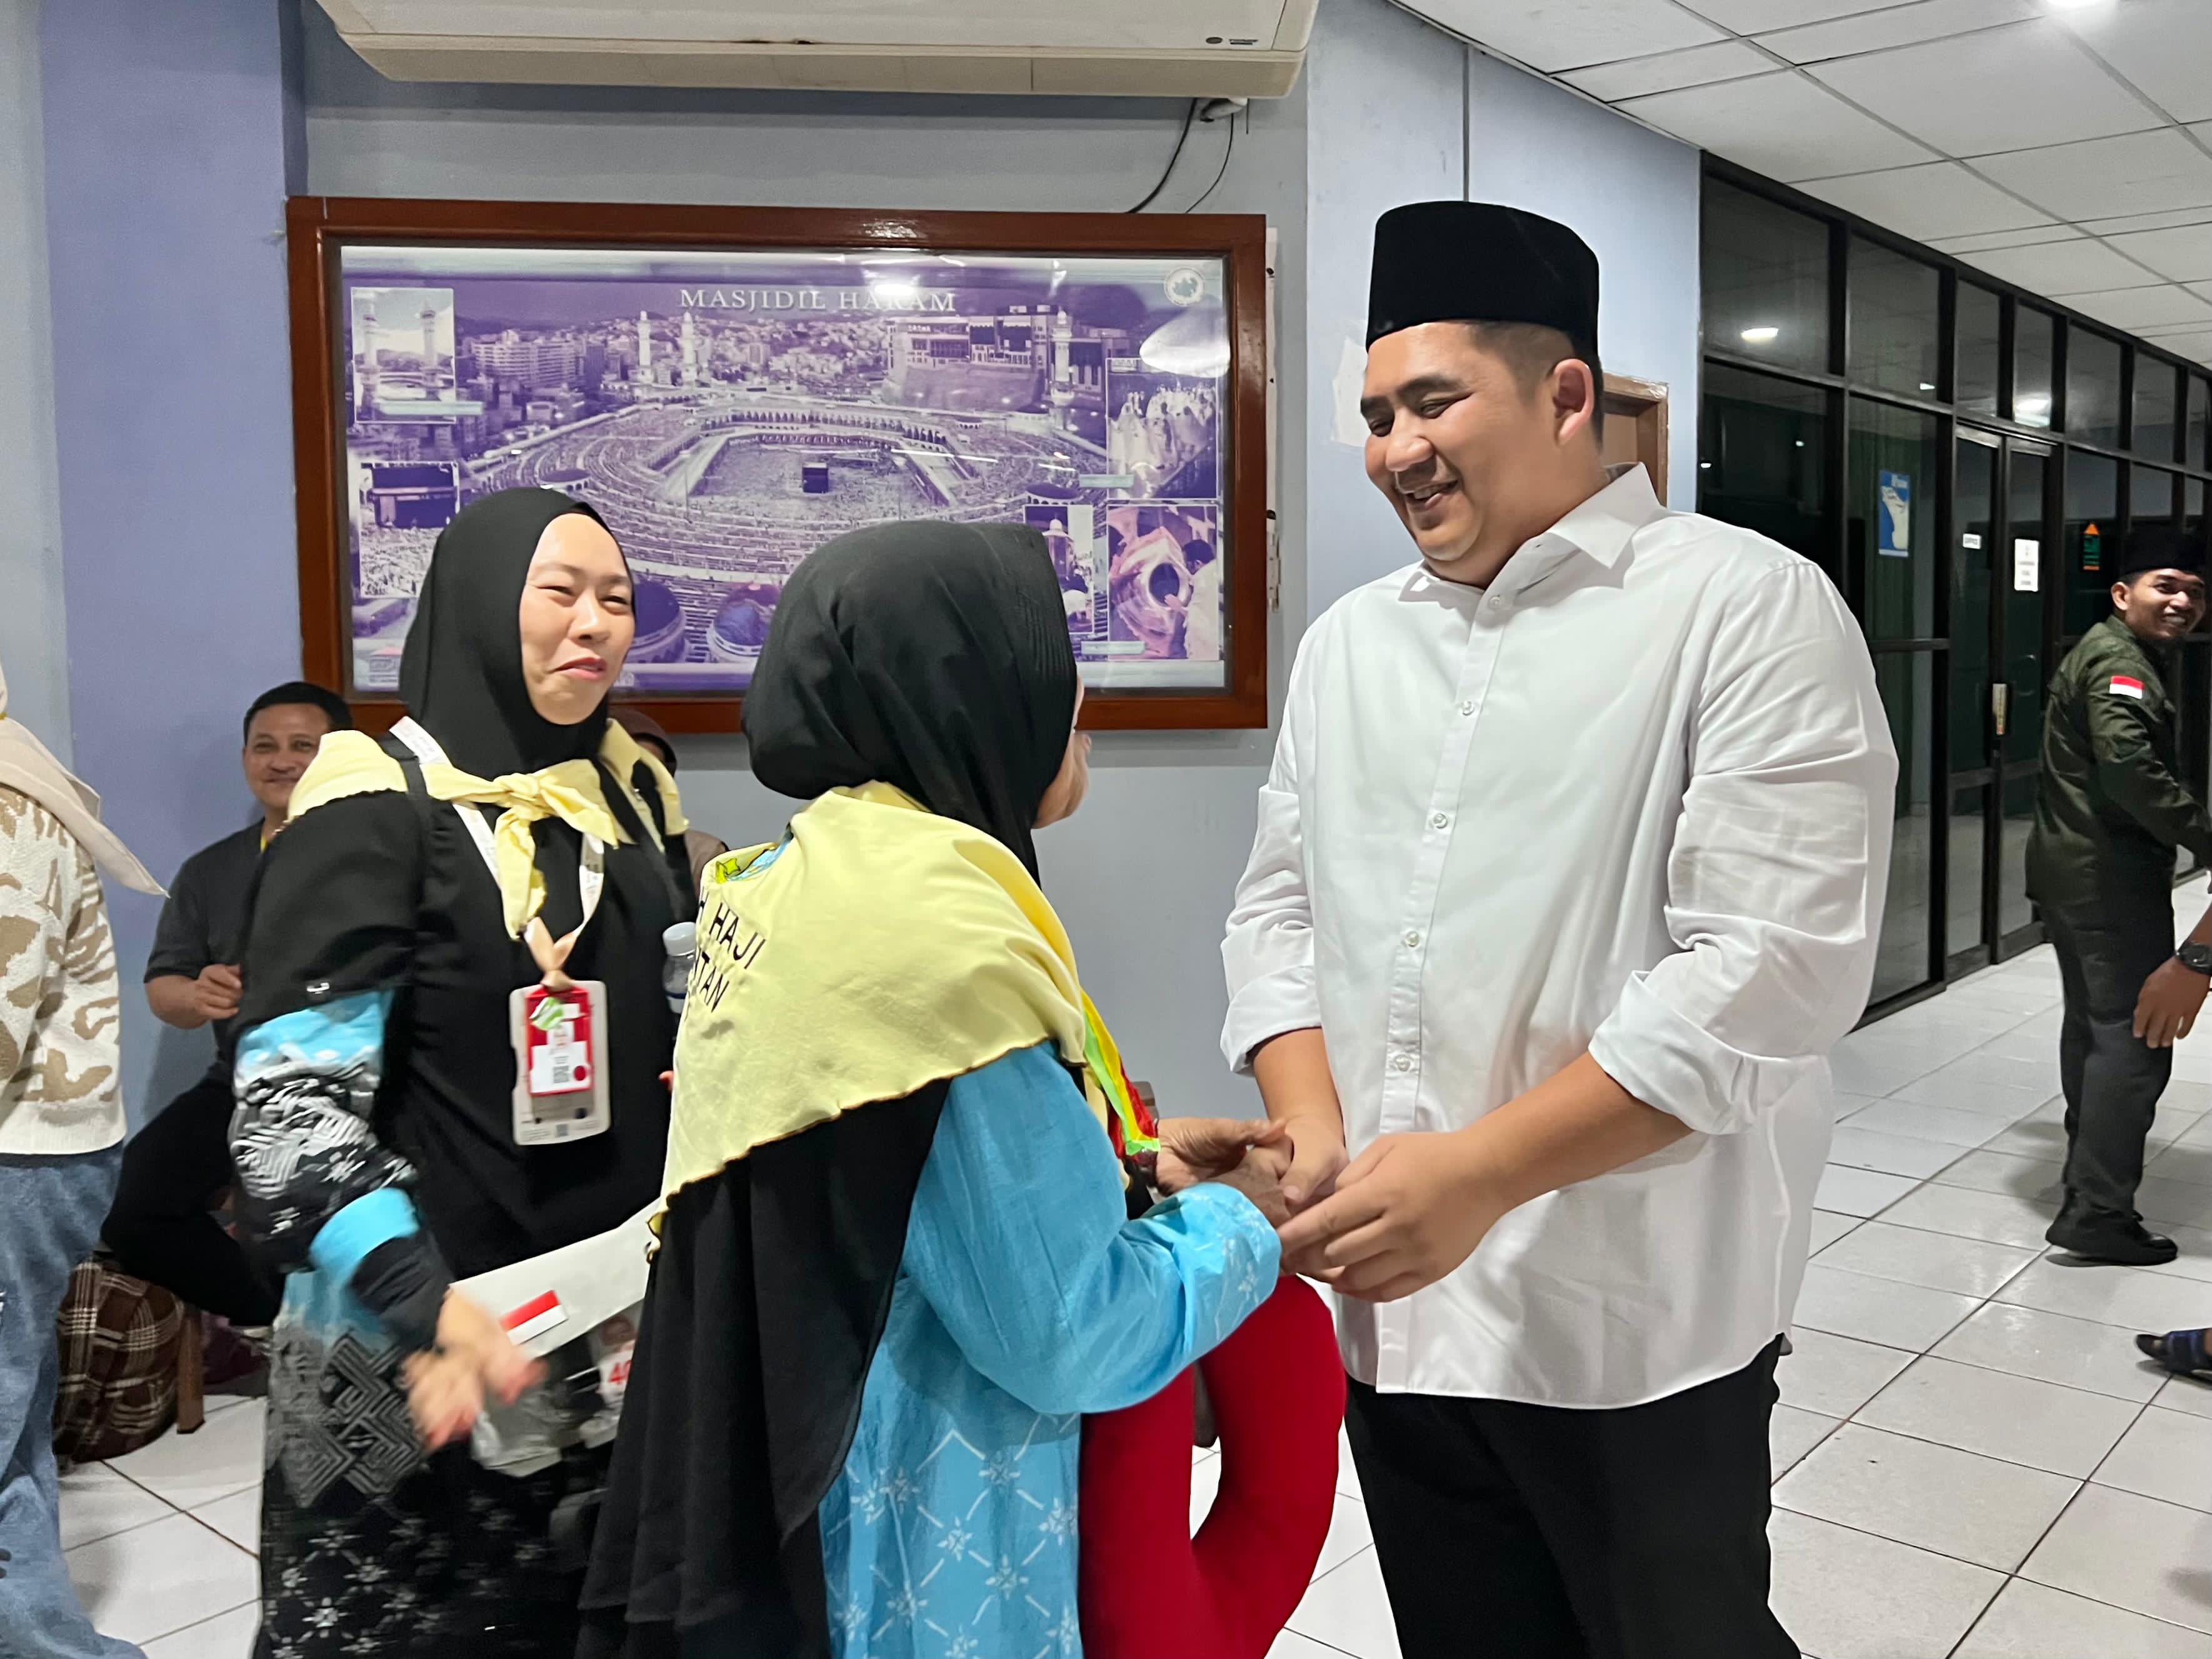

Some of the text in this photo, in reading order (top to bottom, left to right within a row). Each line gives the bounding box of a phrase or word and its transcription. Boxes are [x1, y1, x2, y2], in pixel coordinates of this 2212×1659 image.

[680, 289, 956, 312] MASJIDIL HARAM
[708, 902, 766, 970] HAJI
